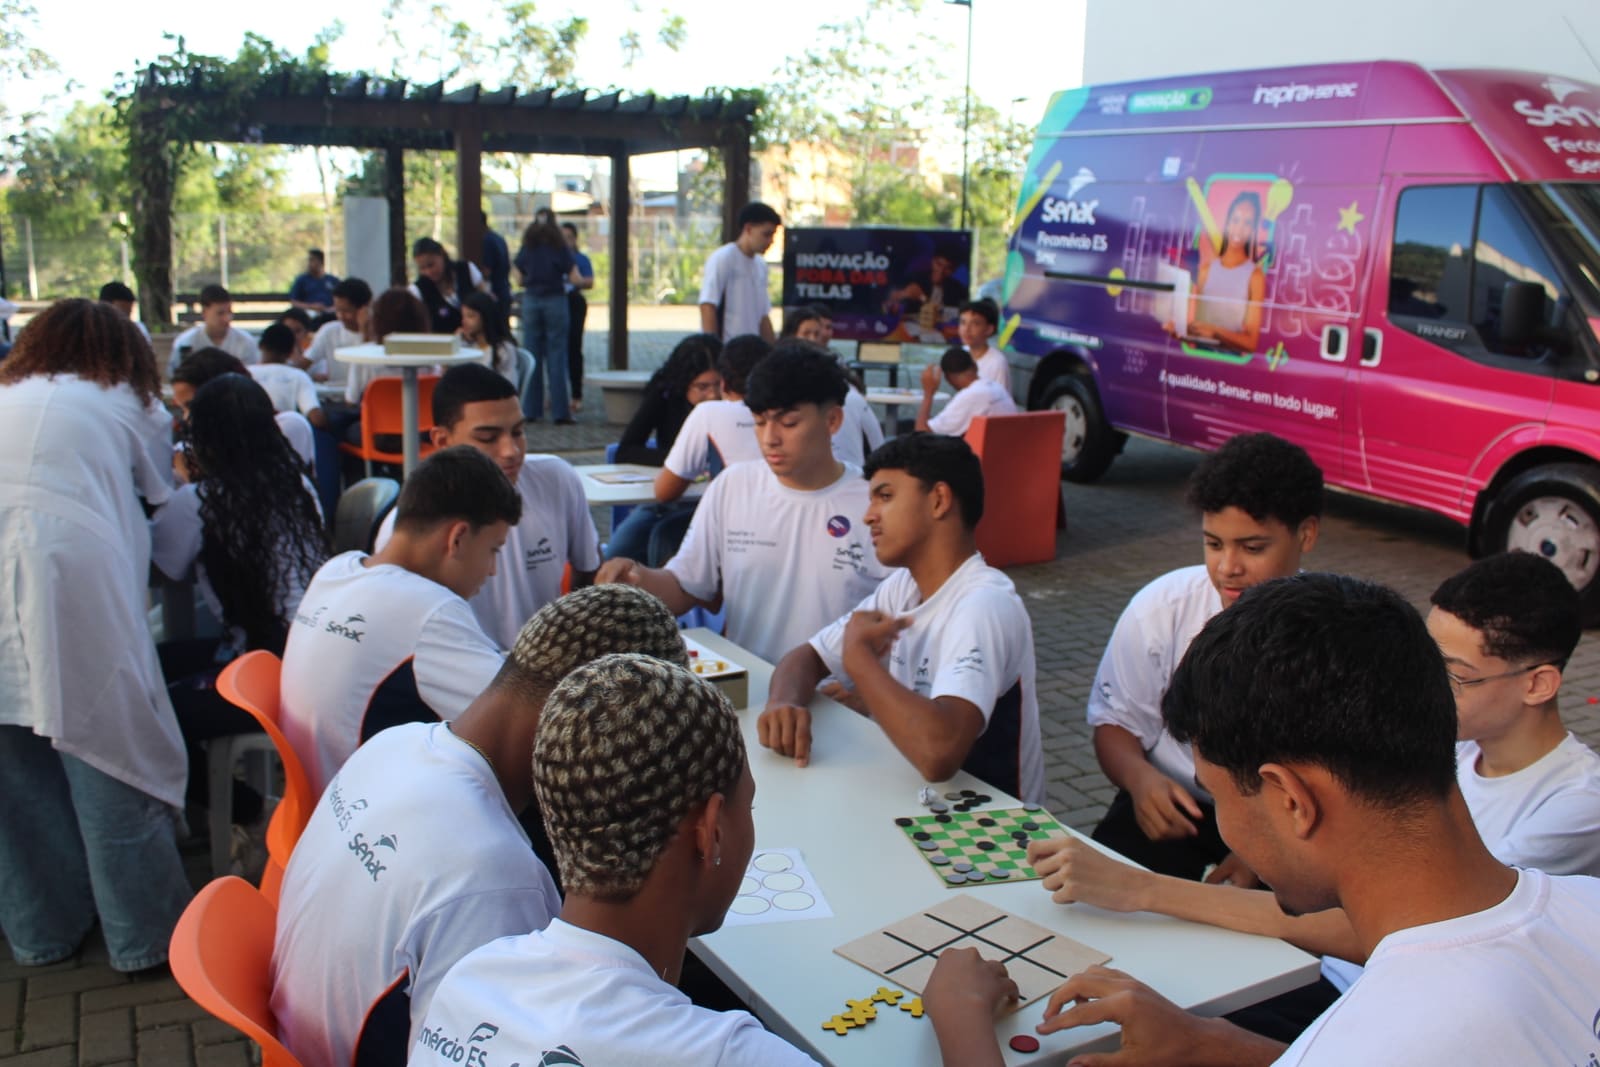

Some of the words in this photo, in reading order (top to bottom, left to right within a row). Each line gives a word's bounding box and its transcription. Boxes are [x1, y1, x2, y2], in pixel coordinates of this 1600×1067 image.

[1513, 99, 1600, 128] Sen
[1041, 197, 1099, 226] Senac
[796, 251, 890, 271] INOVAÇÃO
[796, 269, 847, 284] FORA
[850, 271, 888, 285] DAS
[796, 283, 853, 299] TELAS
[1416, 323, 1467, 341] TRANSIT
[1159, 369, 1167, 382] A
[1167, 372, 1217, 394] qualidade
[1218, 382, 1251, 401] Senac
[1252, 390, 1272, 405] em
[1273, 394, 1301, 412] todo
[1302, 399, 1338, 420] lugar.
[326, 620, 365, 643] Senac
[348, 832, 387, 882] Senac
